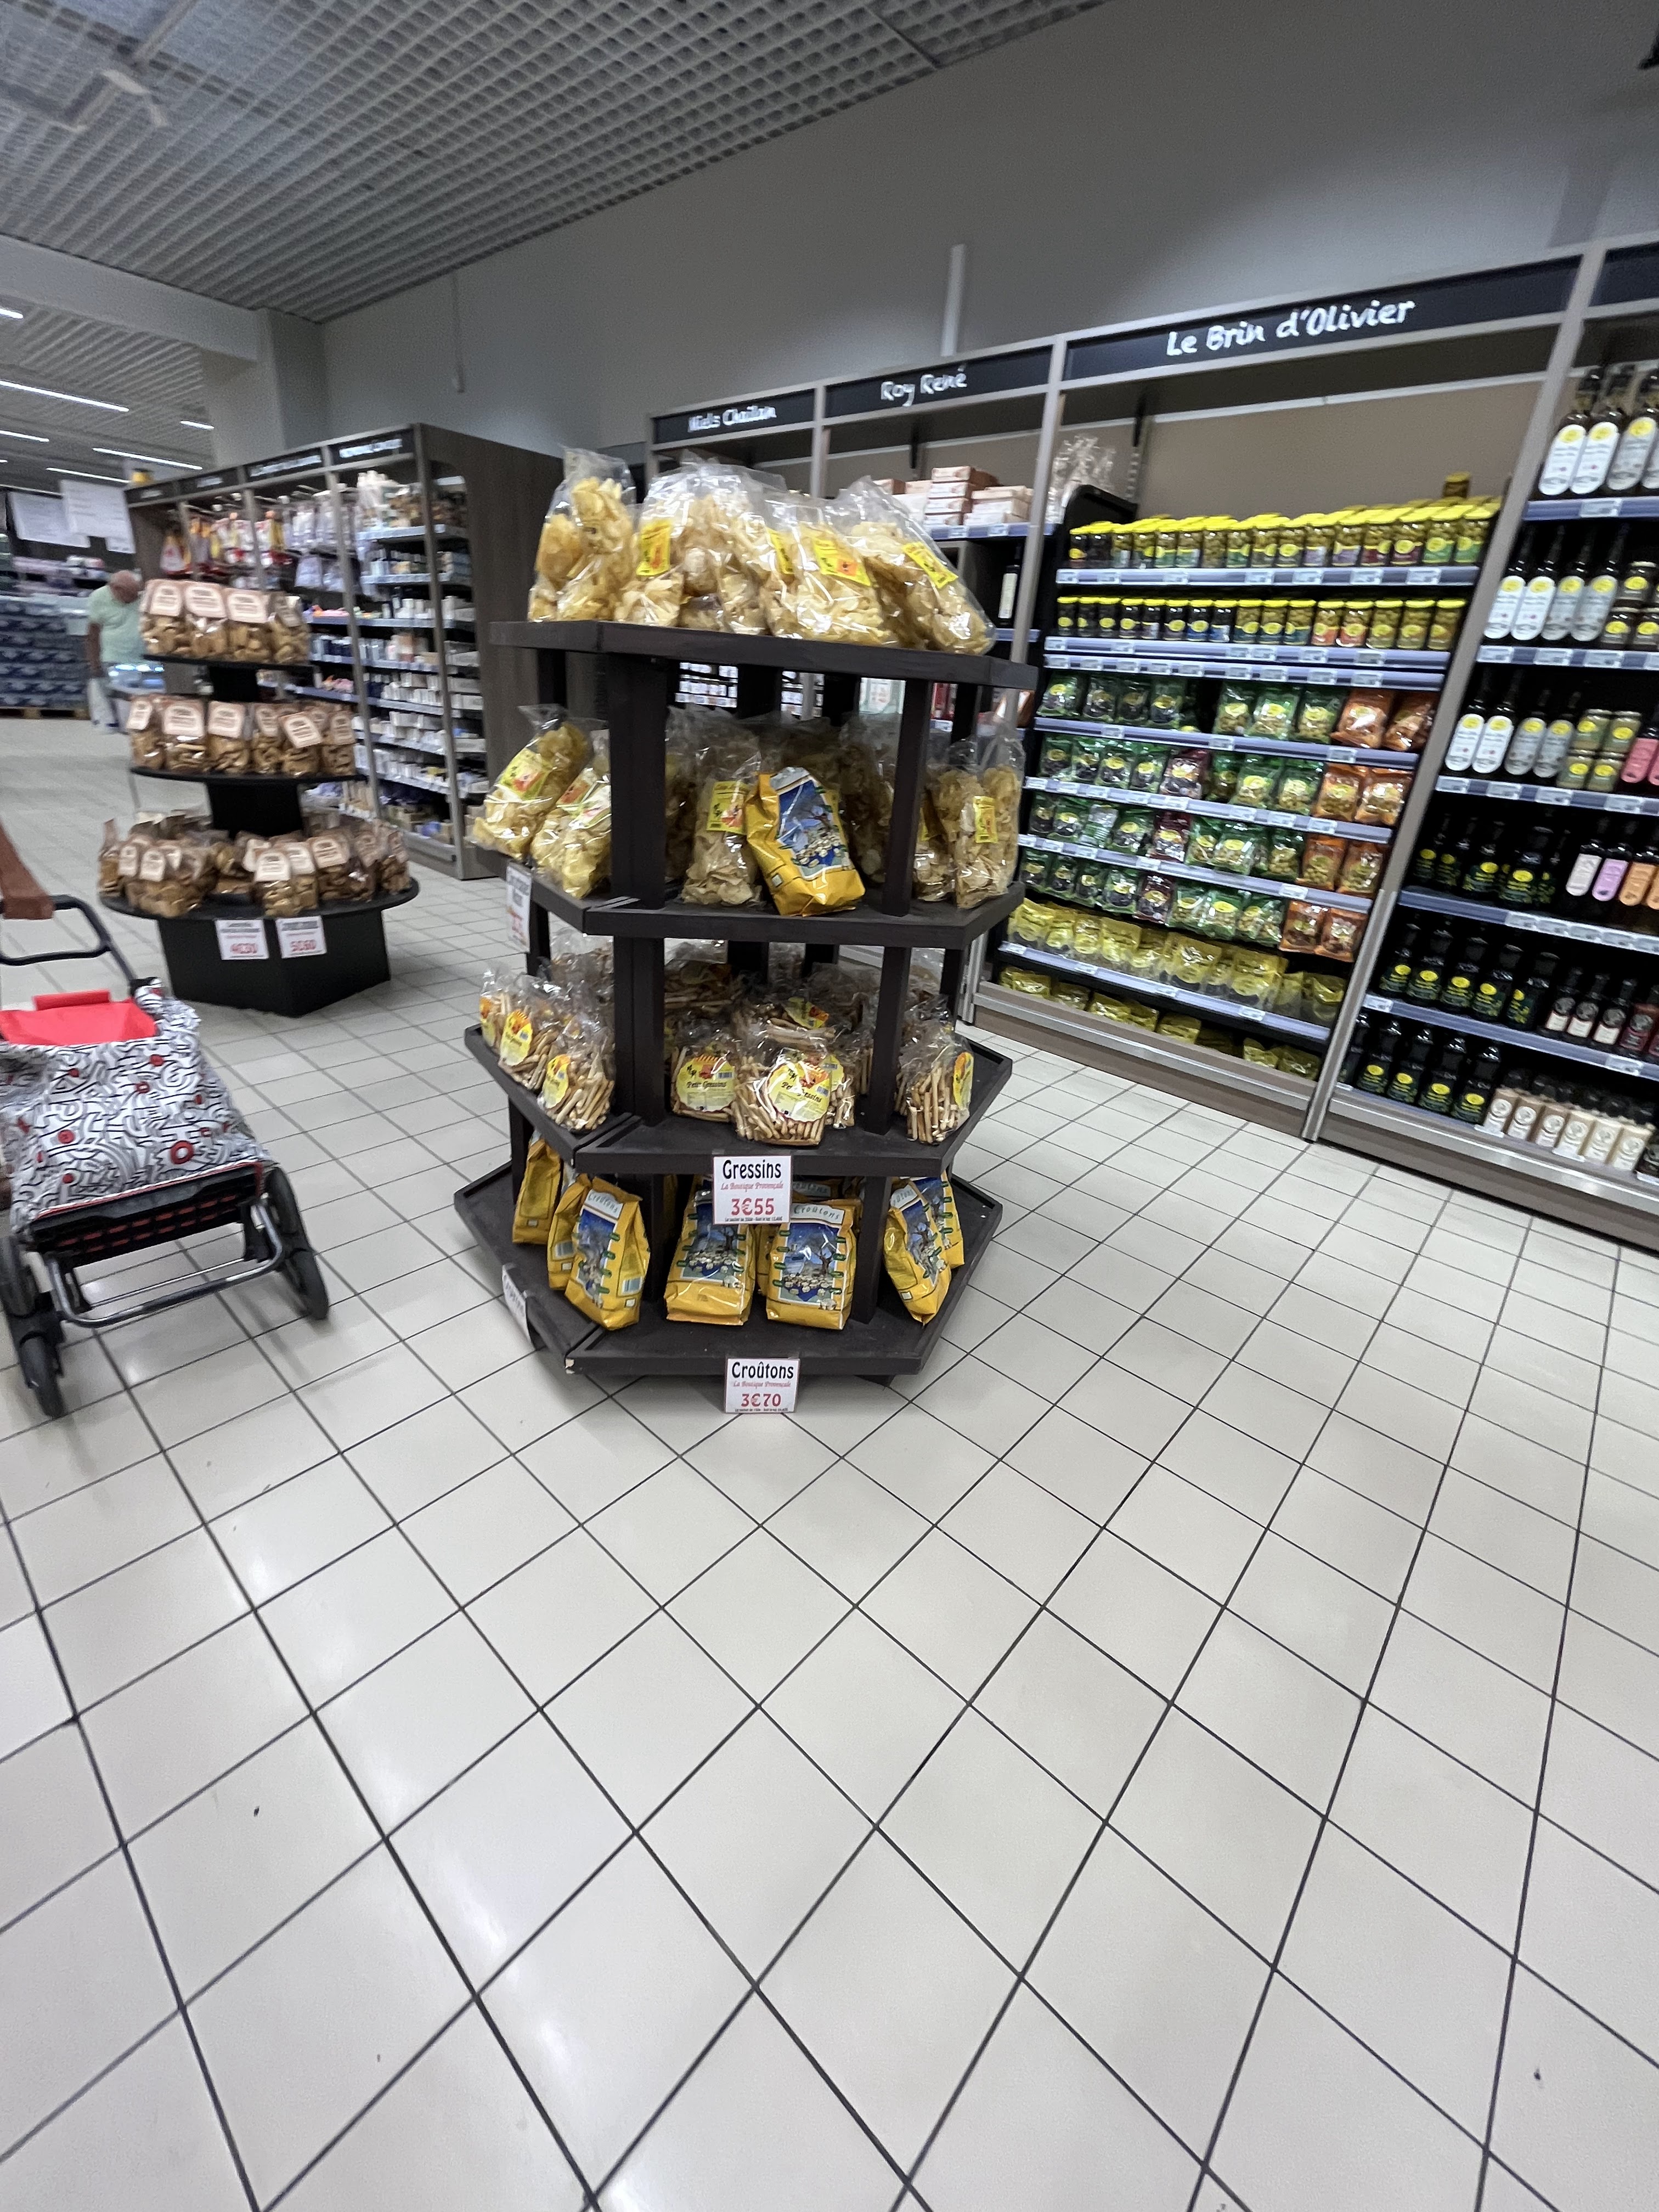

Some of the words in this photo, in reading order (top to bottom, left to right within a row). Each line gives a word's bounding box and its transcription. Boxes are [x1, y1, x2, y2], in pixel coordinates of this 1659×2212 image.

[1166, 331, 1198, 356] Le
[1206, 321, 1266, 351] Brin
[1276, 300, 1416, 338] d'Olivier
[881, 381, 916, 407] Roy
[920, 363, 968, 394] René
[723, 1159, 781, 1179] Gressins
[731, 1197, 775, 1215] 3€55
[732, 1361, 794, 1379] Croûtons
[741, 1393, 782, 1407] 3€70
